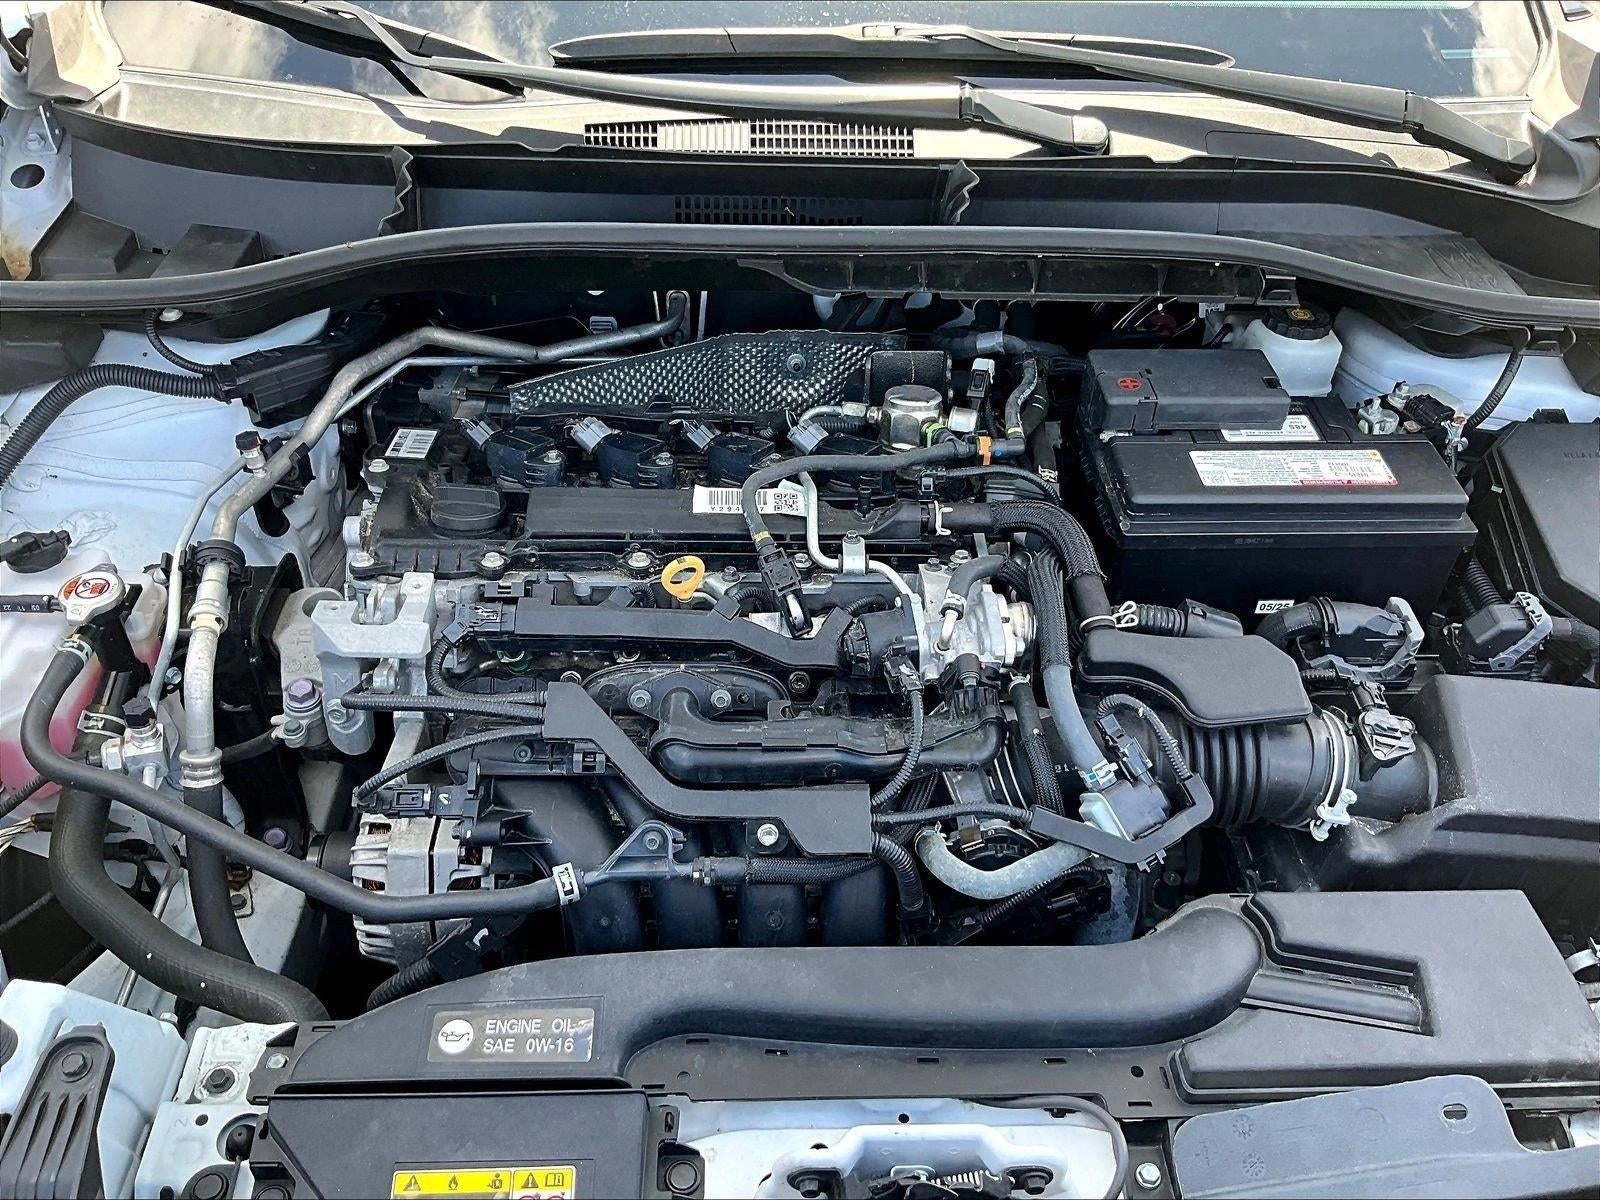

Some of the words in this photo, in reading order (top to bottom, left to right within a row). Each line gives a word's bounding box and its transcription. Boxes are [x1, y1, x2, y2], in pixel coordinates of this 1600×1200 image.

[485, 1019, 543, 1034] ENGINE
[551, 1018, 576, 1032] OIL
[483, 1038, 516, 1053] SAE
[525, 1037, 575, 1053] 0W-16
